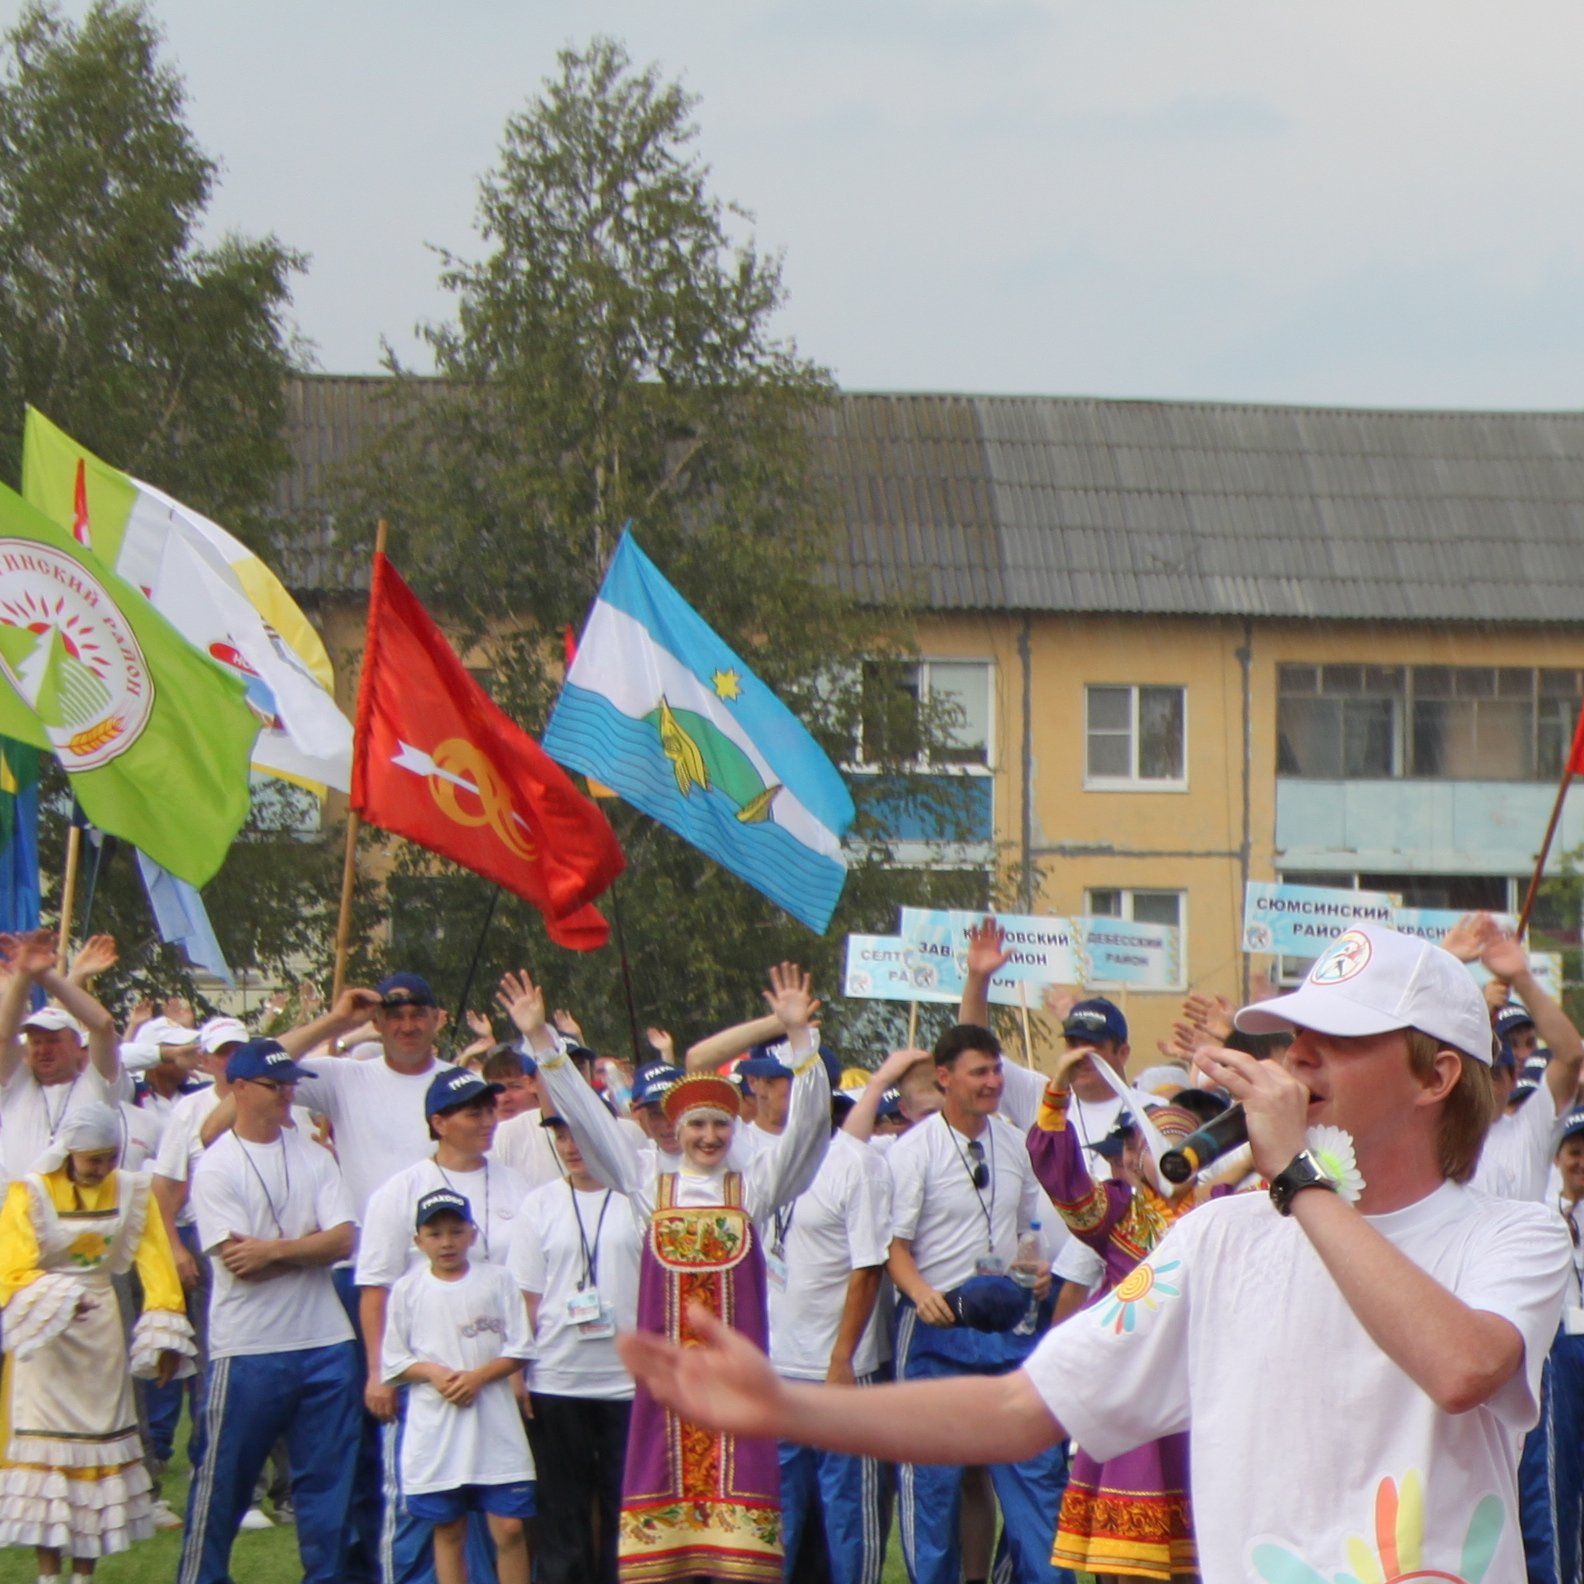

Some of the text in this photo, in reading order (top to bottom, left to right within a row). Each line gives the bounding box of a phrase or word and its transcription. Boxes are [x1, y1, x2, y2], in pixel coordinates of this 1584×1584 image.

[0, 554, 99, 608] ИНСКИЙ
[1256, 898, 1390, 920] СЮМСИНСКИЙ
[1293, 923, 1348, 939] РАЙО
[1006, 950, 1048, 966] АЙОН
[1105, 953, 1149, 967] РАЙОН
[422, 1194, 465, 1210] ГРАХОВО
